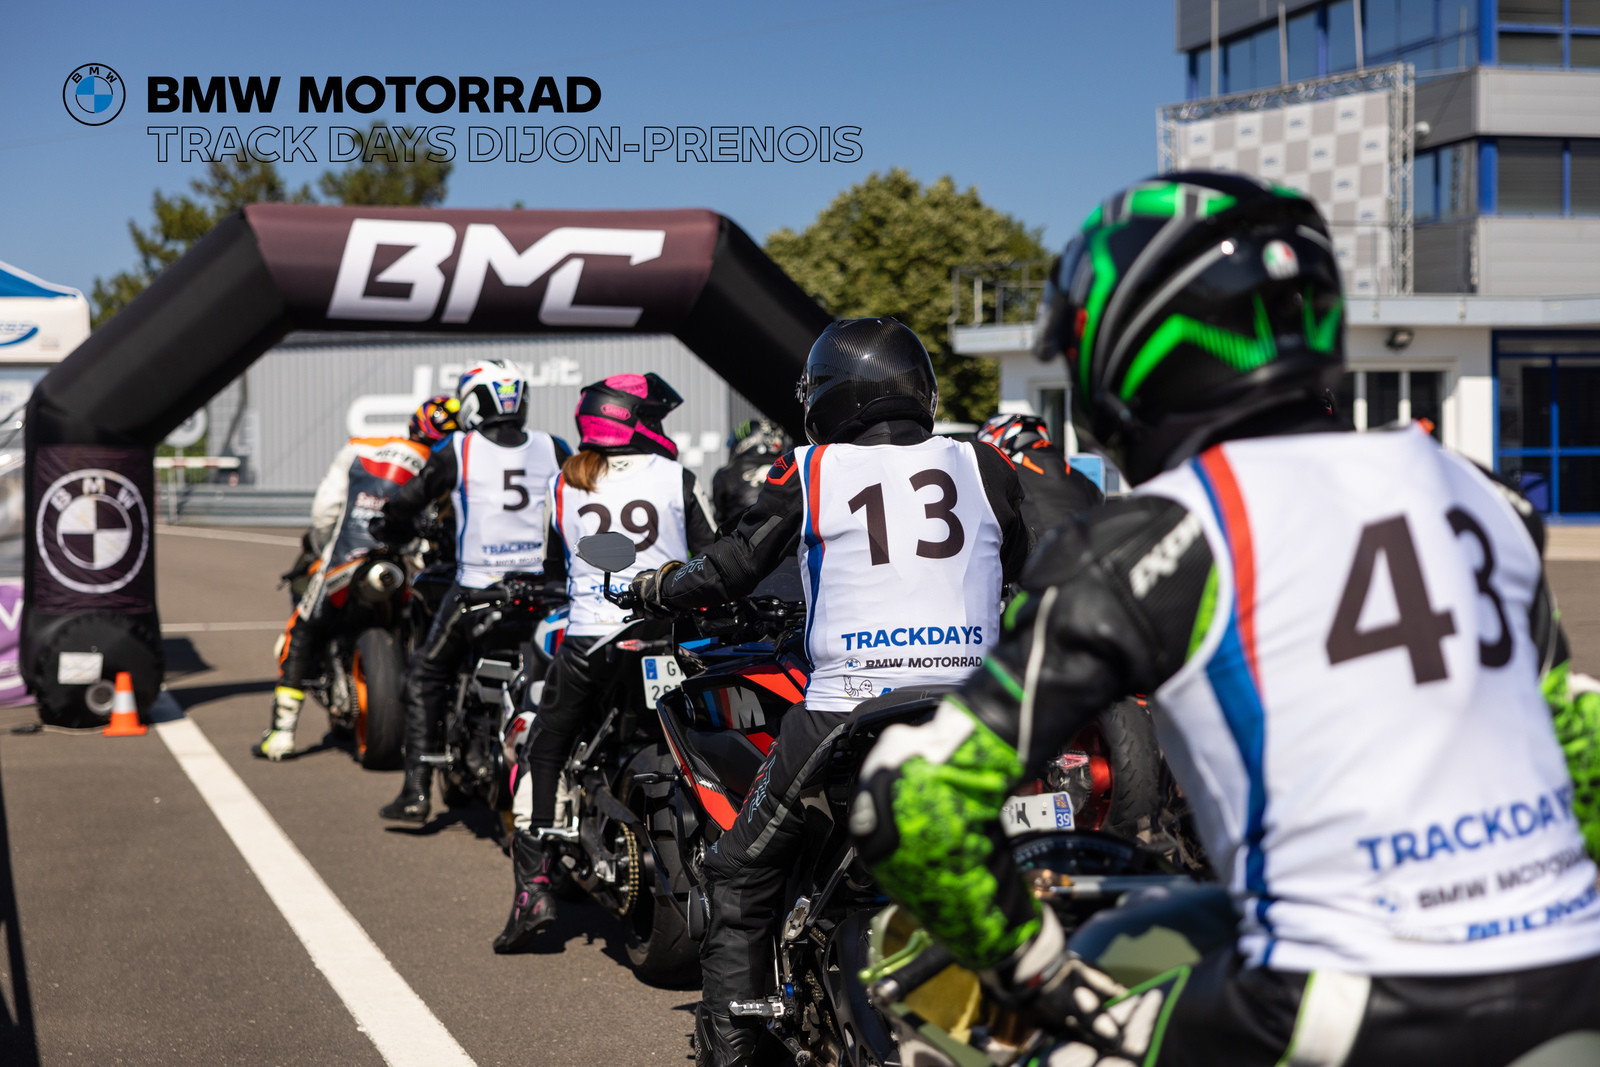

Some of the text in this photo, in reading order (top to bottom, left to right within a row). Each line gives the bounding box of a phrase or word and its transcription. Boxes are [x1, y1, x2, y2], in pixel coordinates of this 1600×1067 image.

[327, 218, 666, 327] BMC
[50, 476, 138, 512] BMW
[503, 469, 530, 511] 5
[577, 499, 659, 552] 29
[848, 468, 965, 566] 13
[1326, 505, 1513, 685] 43
[841, 625, 983, 651] TRACKDAYS
[865, 657, 903, 668] BMW
[907, 656, 983, 668] MOTORRAD
